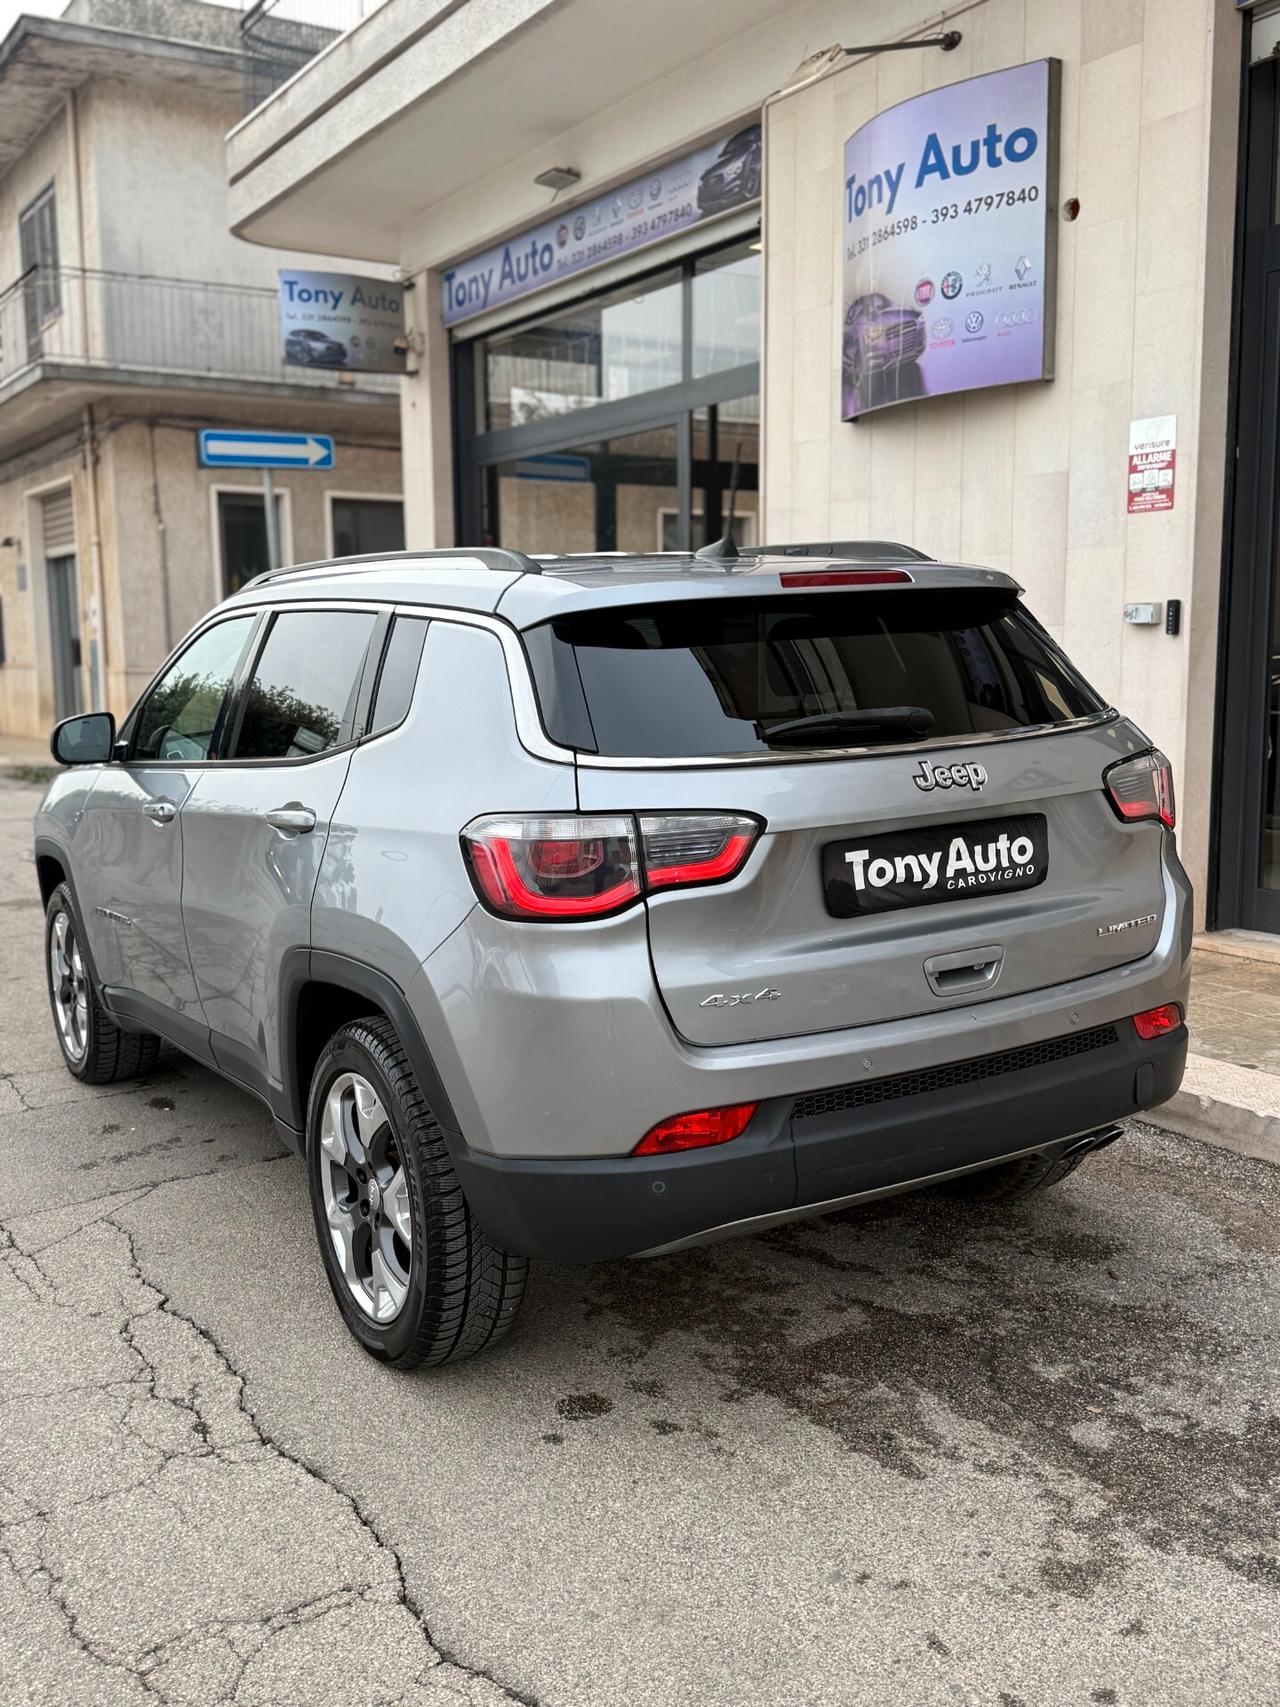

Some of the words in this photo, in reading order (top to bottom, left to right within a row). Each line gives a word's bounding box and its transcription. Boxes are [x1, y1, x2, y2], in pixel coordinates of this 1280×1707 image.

[846, 162, 905, 224] Tony
[914, 123, 1038, 189] Auto
[650, 202, 693, 230] 4797840
[872, 215, 918, 247] 2864598
[931, 203, 958, 225] 393
[963, 186, 1039, 216] 4797840
[444, 271, 493, 312] Tony
[498, 240, 554, 291] Auto
[1008, 280, 1037, 290] RENAULT
[283, 280, 344, 311] Tony
[350, 285, 400, 313] Auto
[1131, 451, 1173, 466] ALLARME
[1134, 439, 1171, 450] verisure
[912, 760, 988, 791] Jeep
[947, 864, 1035, 890] CAROVIGNO
[1097, 914, 1157, 937] LIMITED
